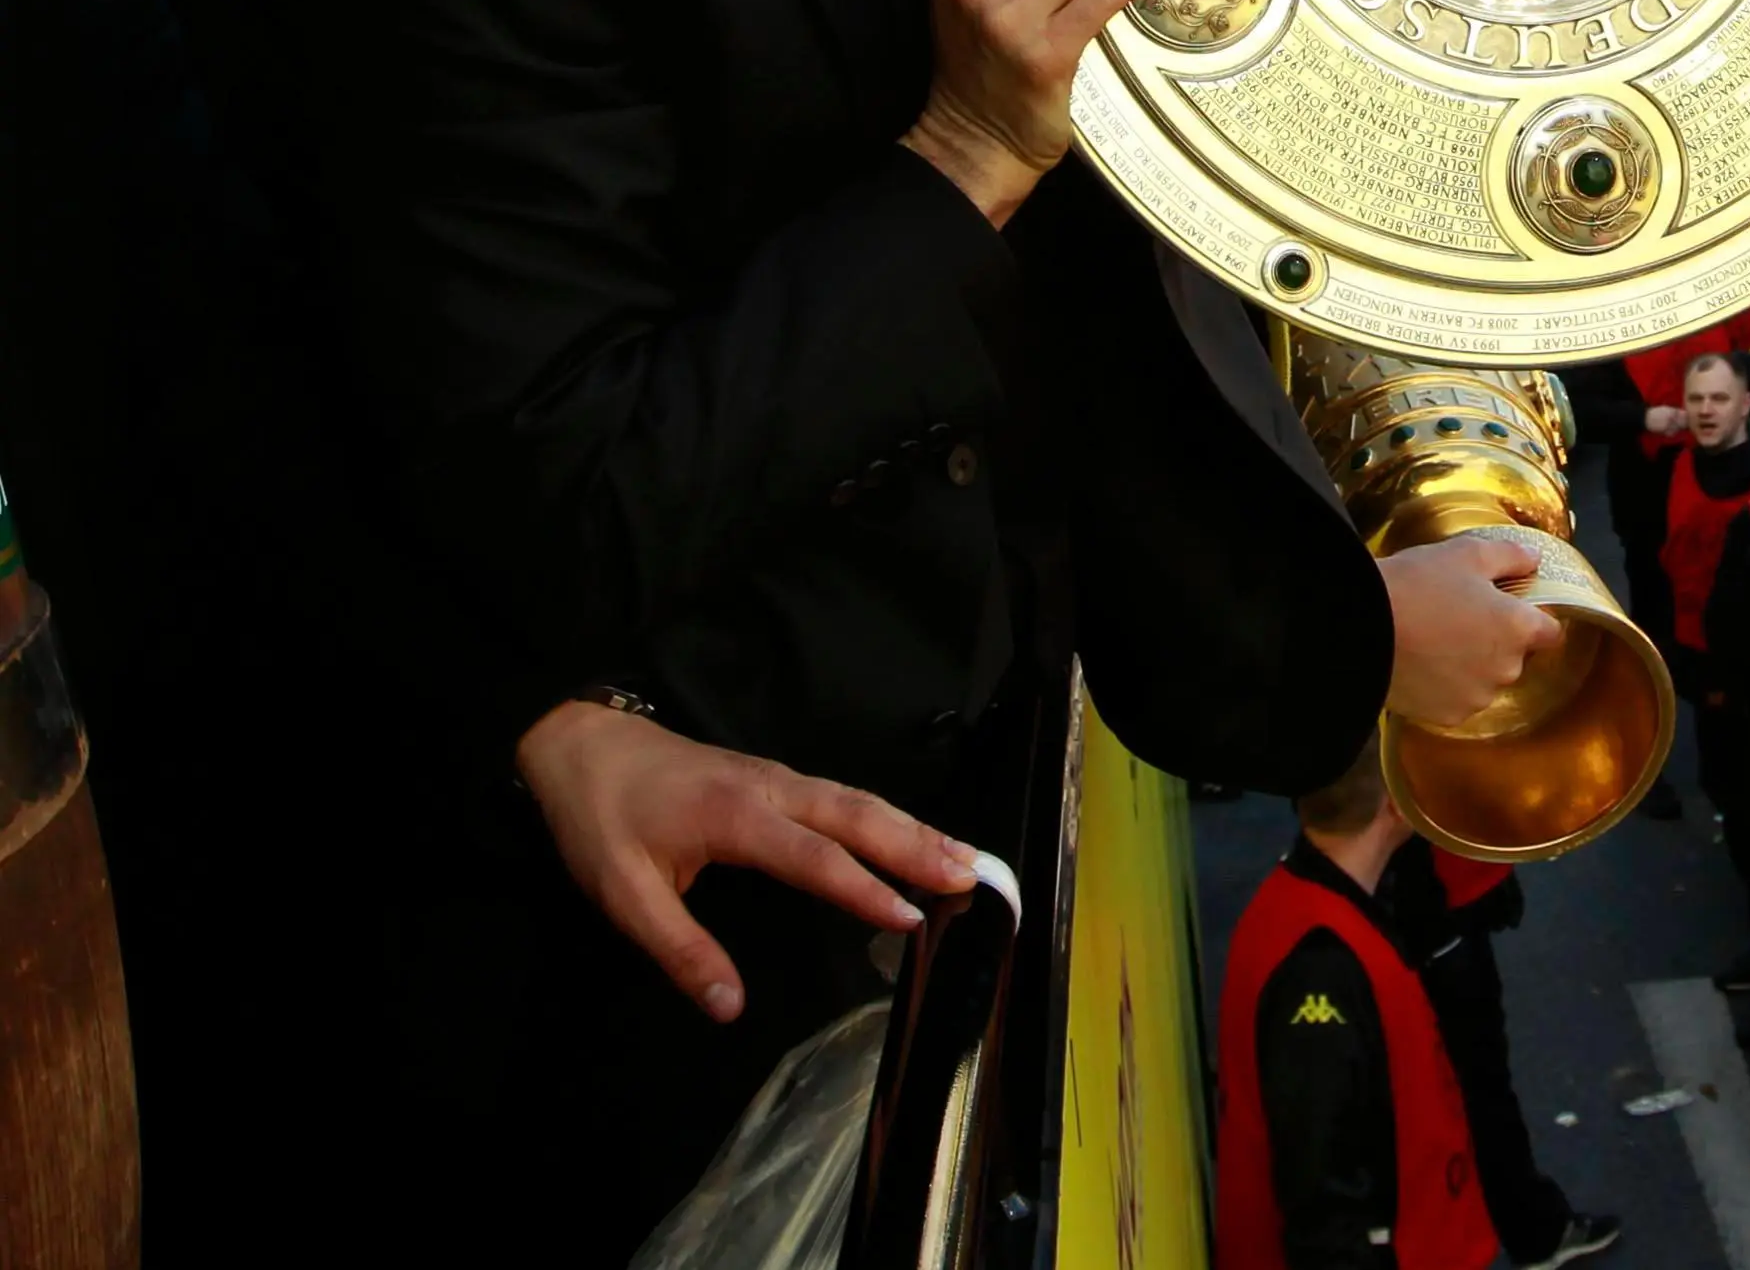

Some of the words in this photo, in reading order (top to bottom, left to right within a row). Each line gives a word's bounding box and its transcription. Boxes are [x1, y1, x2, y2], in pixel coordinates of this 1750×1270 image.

[1095, 97, 1113, 117] FC
[1187, 85, 1213, 113] VFB
[1206, 106, 1233, 132] 1913
[1233, 131, 1263, 158] KIEL
[1105, 149, 1165, 211] MÜNCHEN
[1131, 144, 1201, 213] WOLFSBURG
[1258, 151, 1323, 199] HOLSTEIN
[1694, 164, 1713, 182] 04
[1320, 189, 1347, 211] 1912
[1161, 203, 1208, 245] BAYERN
[1199, 207, 1228, 233] VFL
[1354, 205, 1404, 233] BERLIN
[1225, 226, 1254, 252] 2009
[1404, 222, 1470, 247] VIKTORIA
[1472, 235, 1497, 250] 1911
[1203, 237, 1225, 257] FC
[1222, 250, 1249, 273] 1994
[1331, 283, 1404, 318] MÜNCHEN
[1617, 300, 1644, 318] VFB
[1647, 289, 1679, 310] 2007
[1324, 302, 1382, 332] BREMEN
[1407, 306, 1463, 327] BAYERN
[1467, 315, 1483, 328] FC
[1486, 317, 1518, 330] 2008
[1533, 307, 1616, 329] STUTTGART
[1649, 310, 1680, 331] 1992
[1379, 320, 1444, 345] WERDER
[1448, 333, 1468, 348] SV
[1531, 327, 1616, 350] STUTTGART
[1618, 321, 1646, 339] VFB
[1471, 336, 1501, 350] 1993
